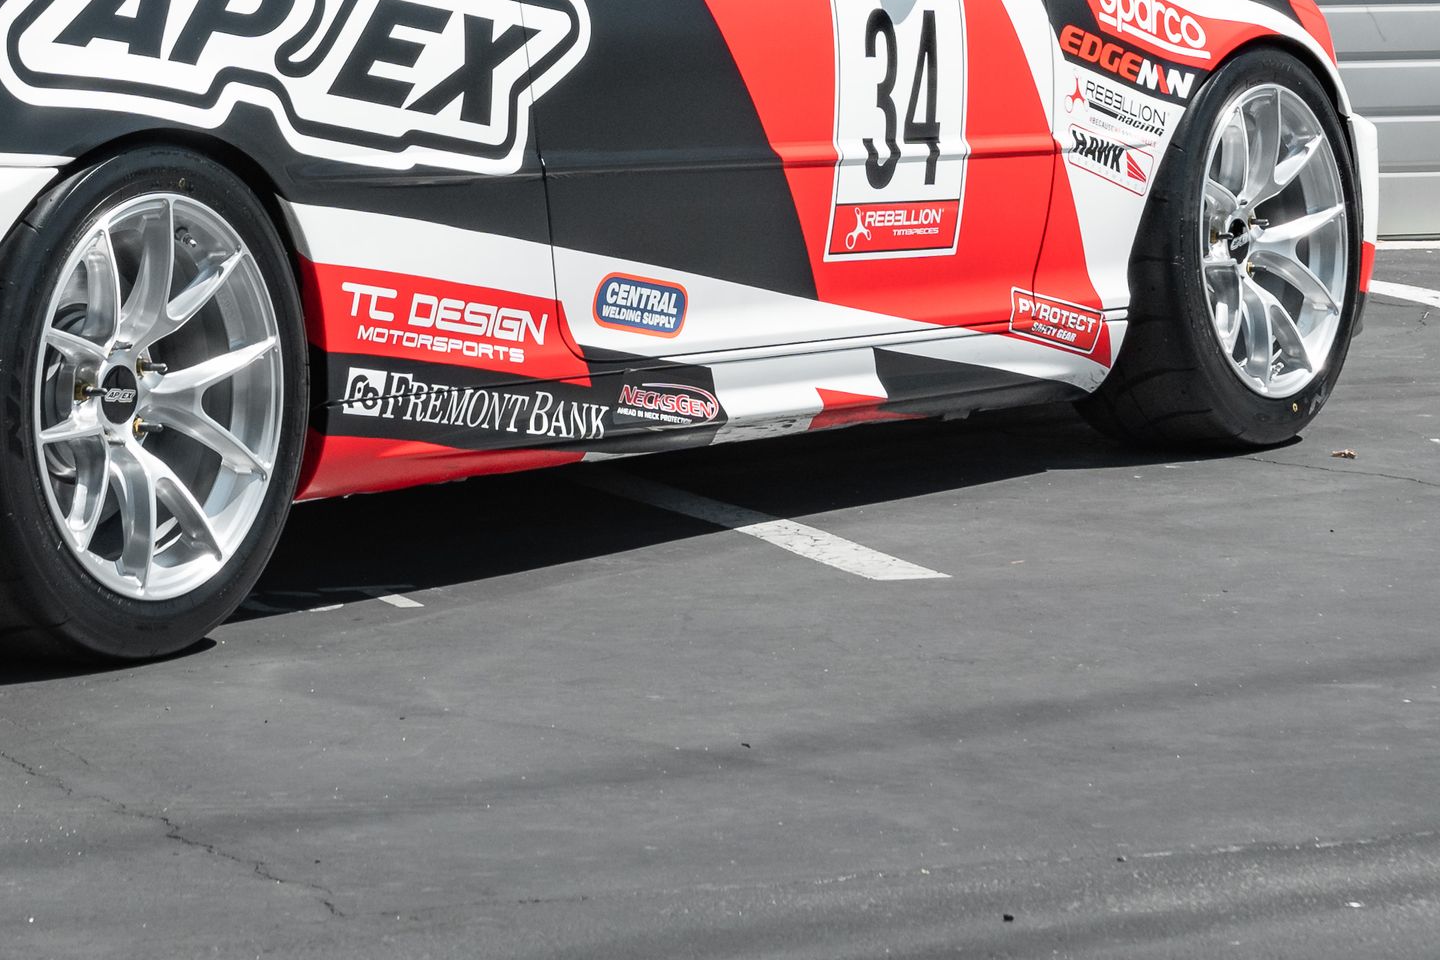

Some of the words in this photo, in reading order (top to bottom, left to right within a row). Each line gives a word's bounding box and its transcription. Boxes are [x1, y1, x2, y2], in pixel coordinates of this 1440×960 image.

[863, 8, 941, 190] 34
[1072, 130, 1125, 174] HAWK
[342, 282, 398, 322] TC
[408, 293, 548, 345] DESIGN
[602, 304, 642, 323] WELDING
[642, 312, 676, 329] SUPPLY
[606, 282, 678, 315] CENTRAL
[1018, 297, 1097, 333] PYROTECT
[357, 325, 526, 363] MOTORSPORTS
[1031, 322, 1056, 337] SAFETY
[1056, 329, 1077, 343] GEAR
[617, 407, 636, 417] AHEAD
[644, 411, 660, 420] NECK
[660, 414, 693, 424] PROTECTION
